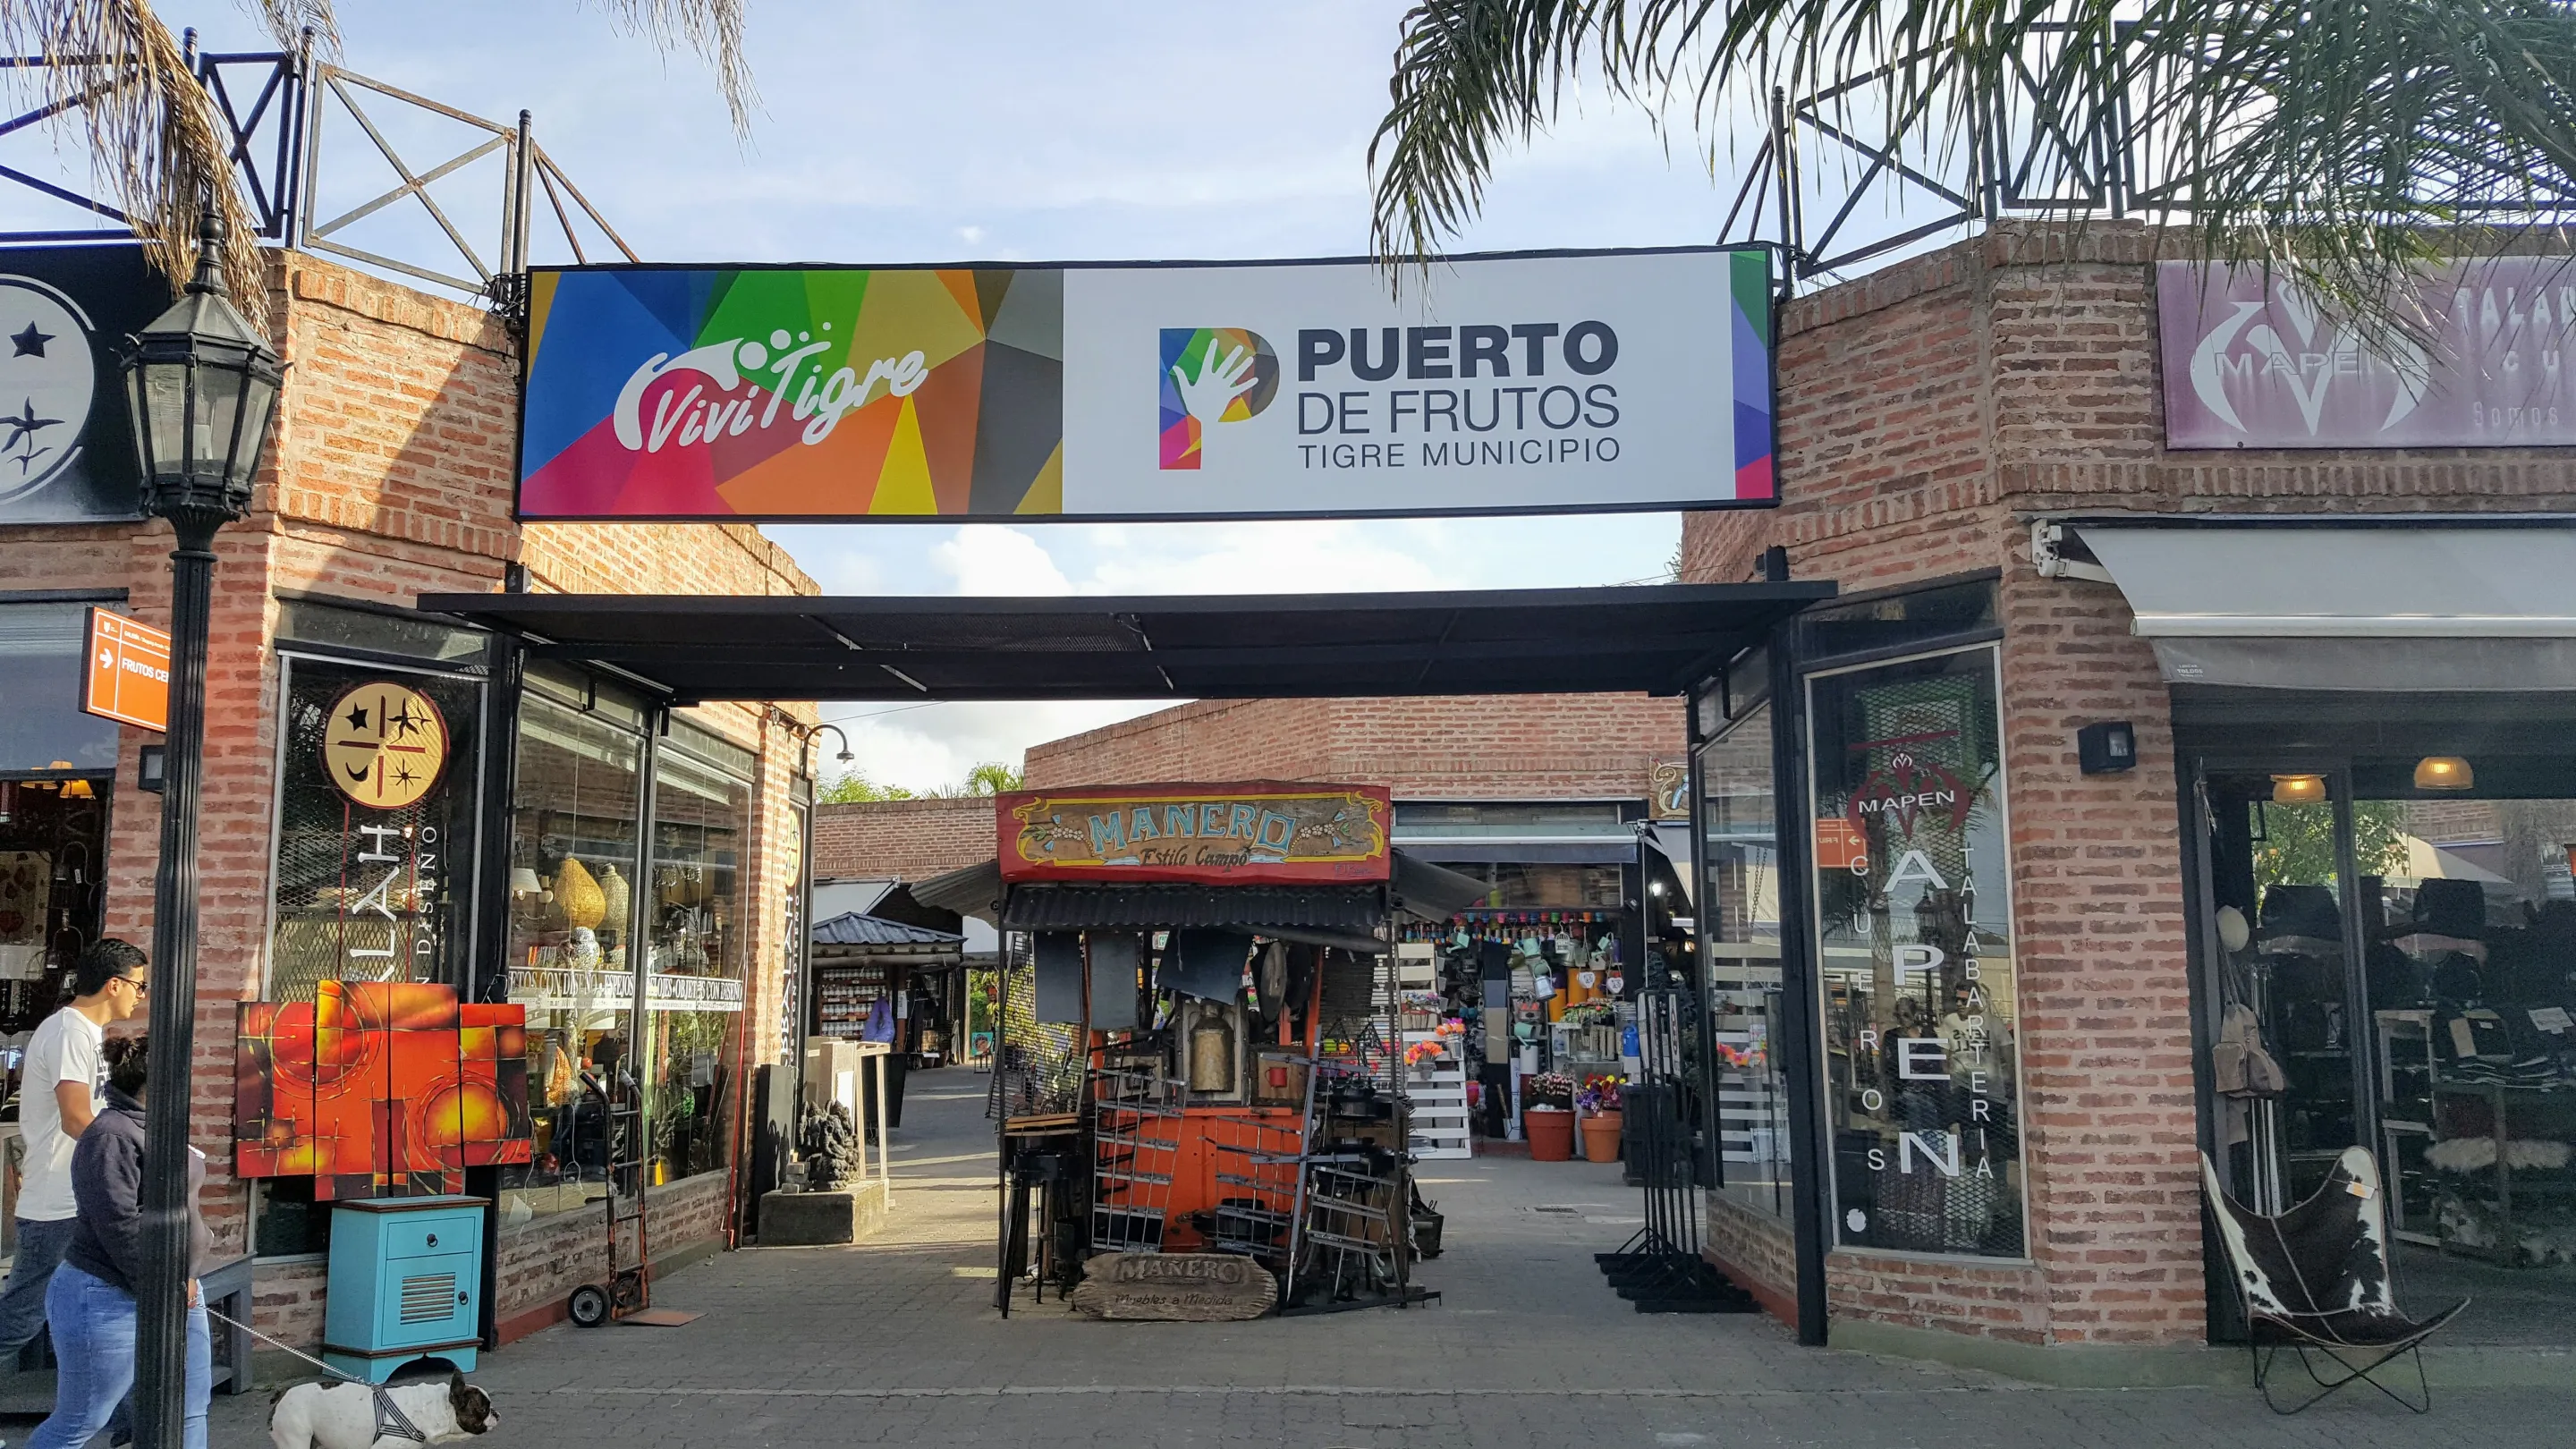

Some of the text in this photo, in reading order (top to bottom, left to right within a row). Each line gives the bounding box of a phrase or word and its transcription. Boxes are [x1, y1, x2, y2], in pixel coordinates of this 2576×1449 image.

[1298, 320, 1619, 382] PUERTO
[2215, 352, 2394, 376] MAPE
[648, 340, 928, 453] Vivi Tigre
[1298, 384, 1620, 435] DE FRUTOS
[1298, 436, 1620, 469] TIGRE MUNICIPIO
[122, 657, 154, 679] FRUTOS
[1859, 790, 1954, 813] MAPEN
[1140, 844, 1189, 867] Estilo
[539, 971, 561, 995] CON
[779, 894, 793, 1067] BBALAH
[1850, 855, 1885, 1172] CUEROS
[1172, 1297, 1180, 1305] a
[1184, 1292, 1233, 1305] Medida
